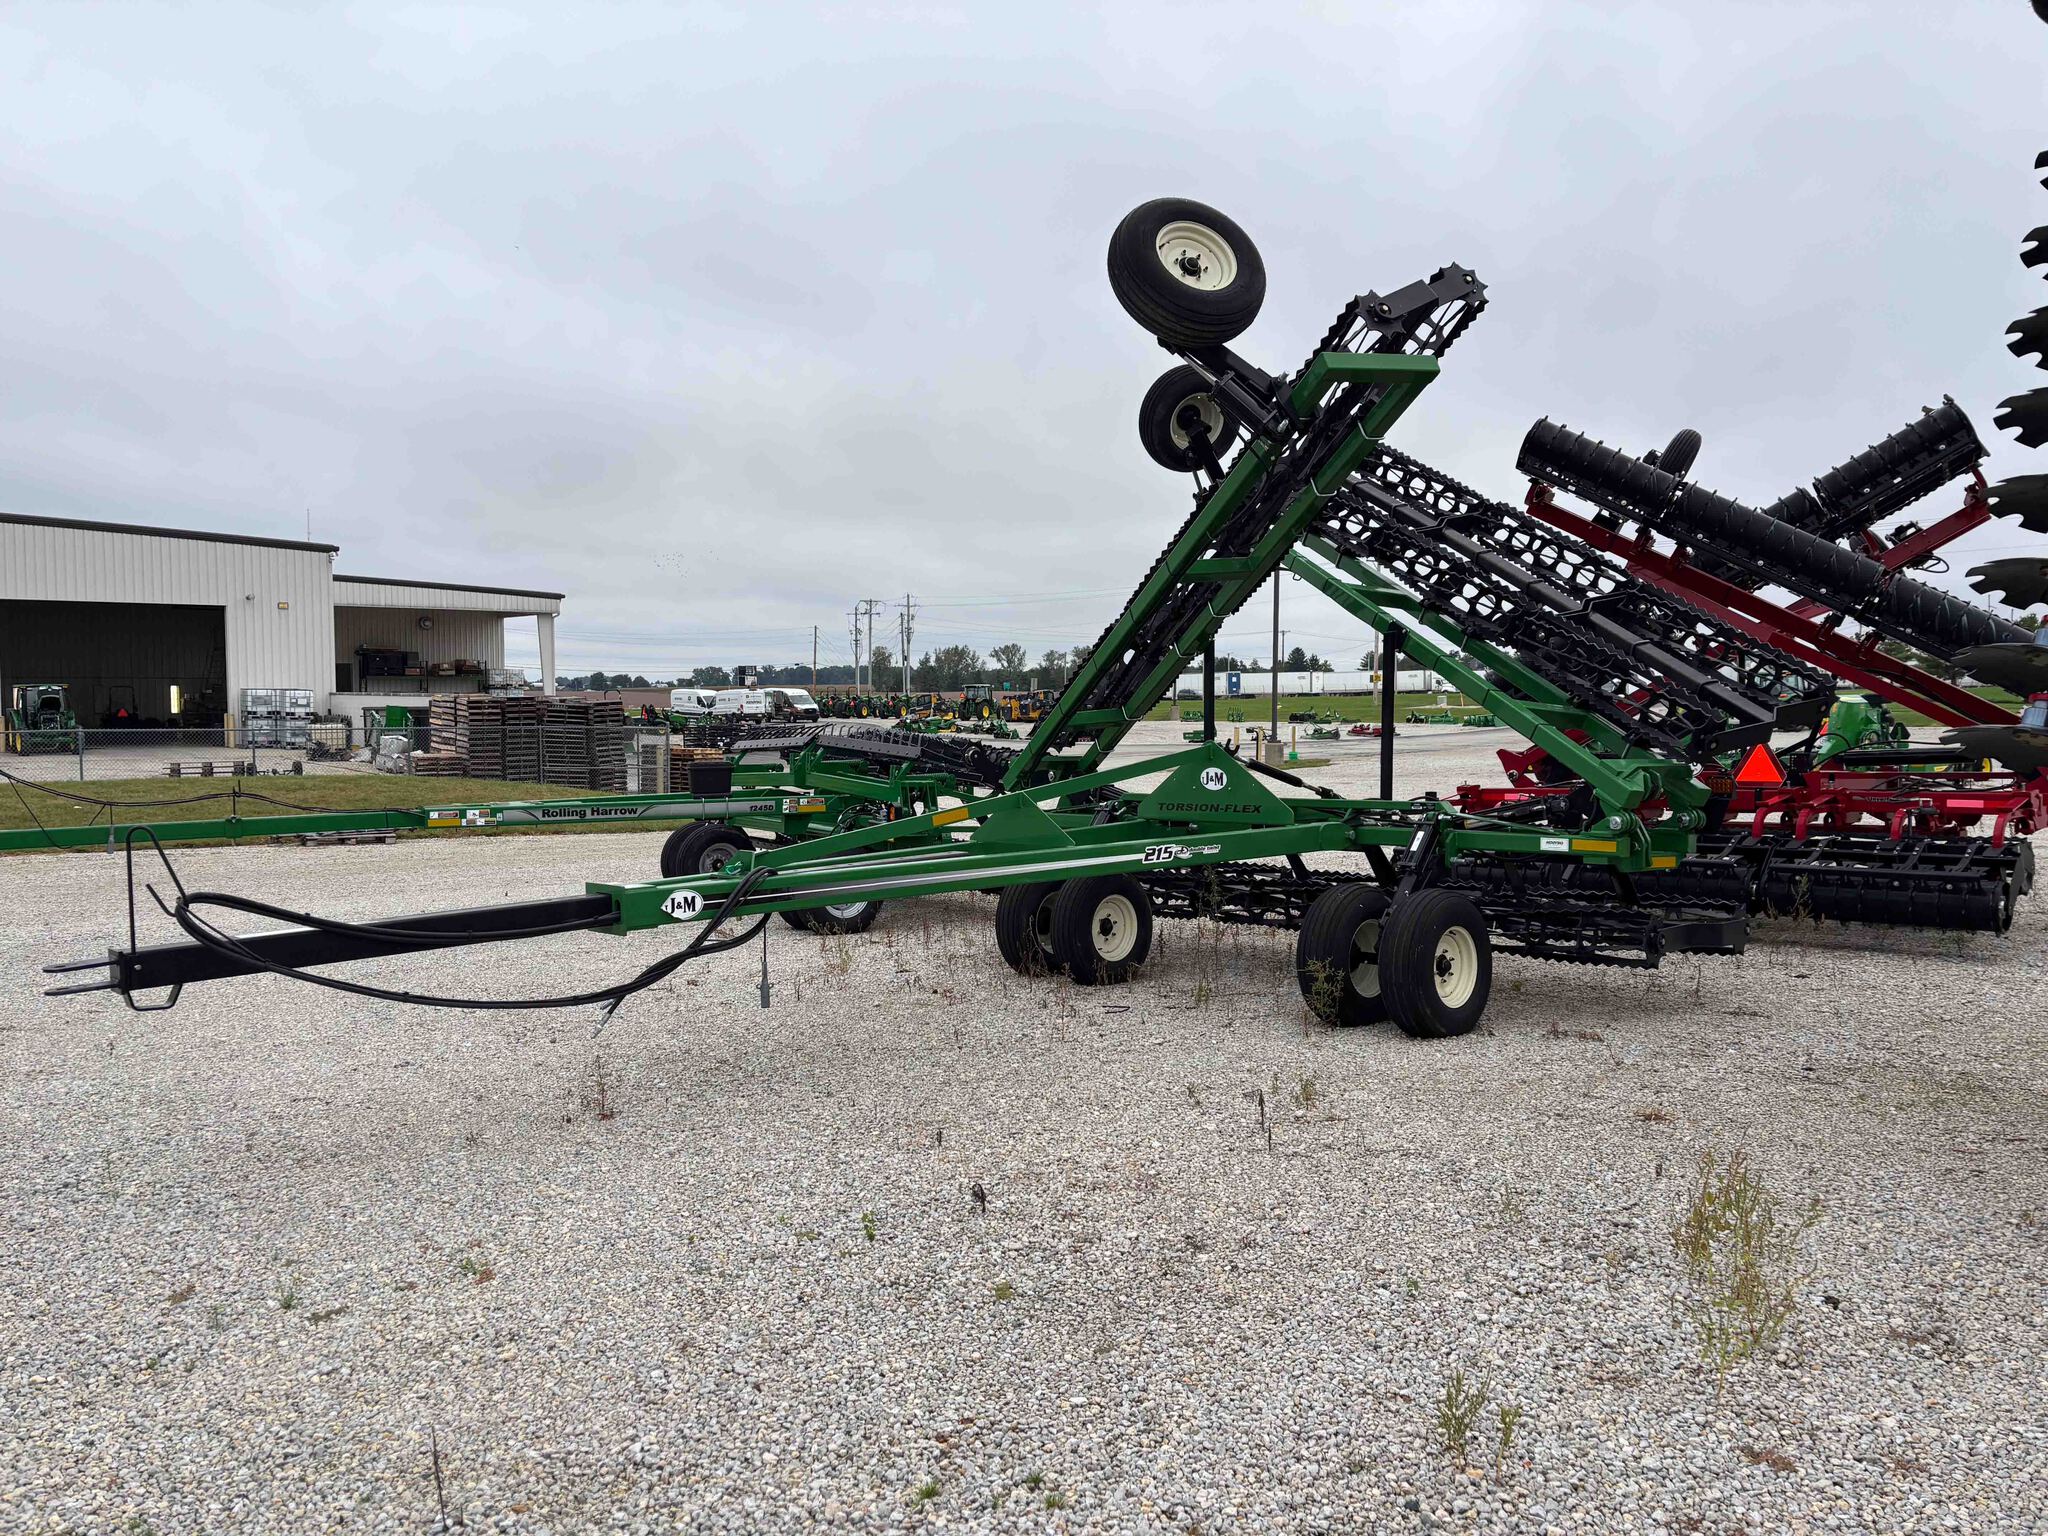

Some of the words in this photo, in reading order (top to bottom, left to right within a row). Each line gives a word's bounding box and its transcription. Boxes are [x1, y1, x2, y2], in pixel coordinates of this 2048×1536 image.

[1202, 771, 1224, 786] J&M
[541, 807, 587, 819] Rolling
[590, 806, 639, 817] Harrow
[1158, 802, 1262, 814] TORSION-FLEX
[1143, 845, 1175, 862] 215
[665, 895, 697, 914] J&M
